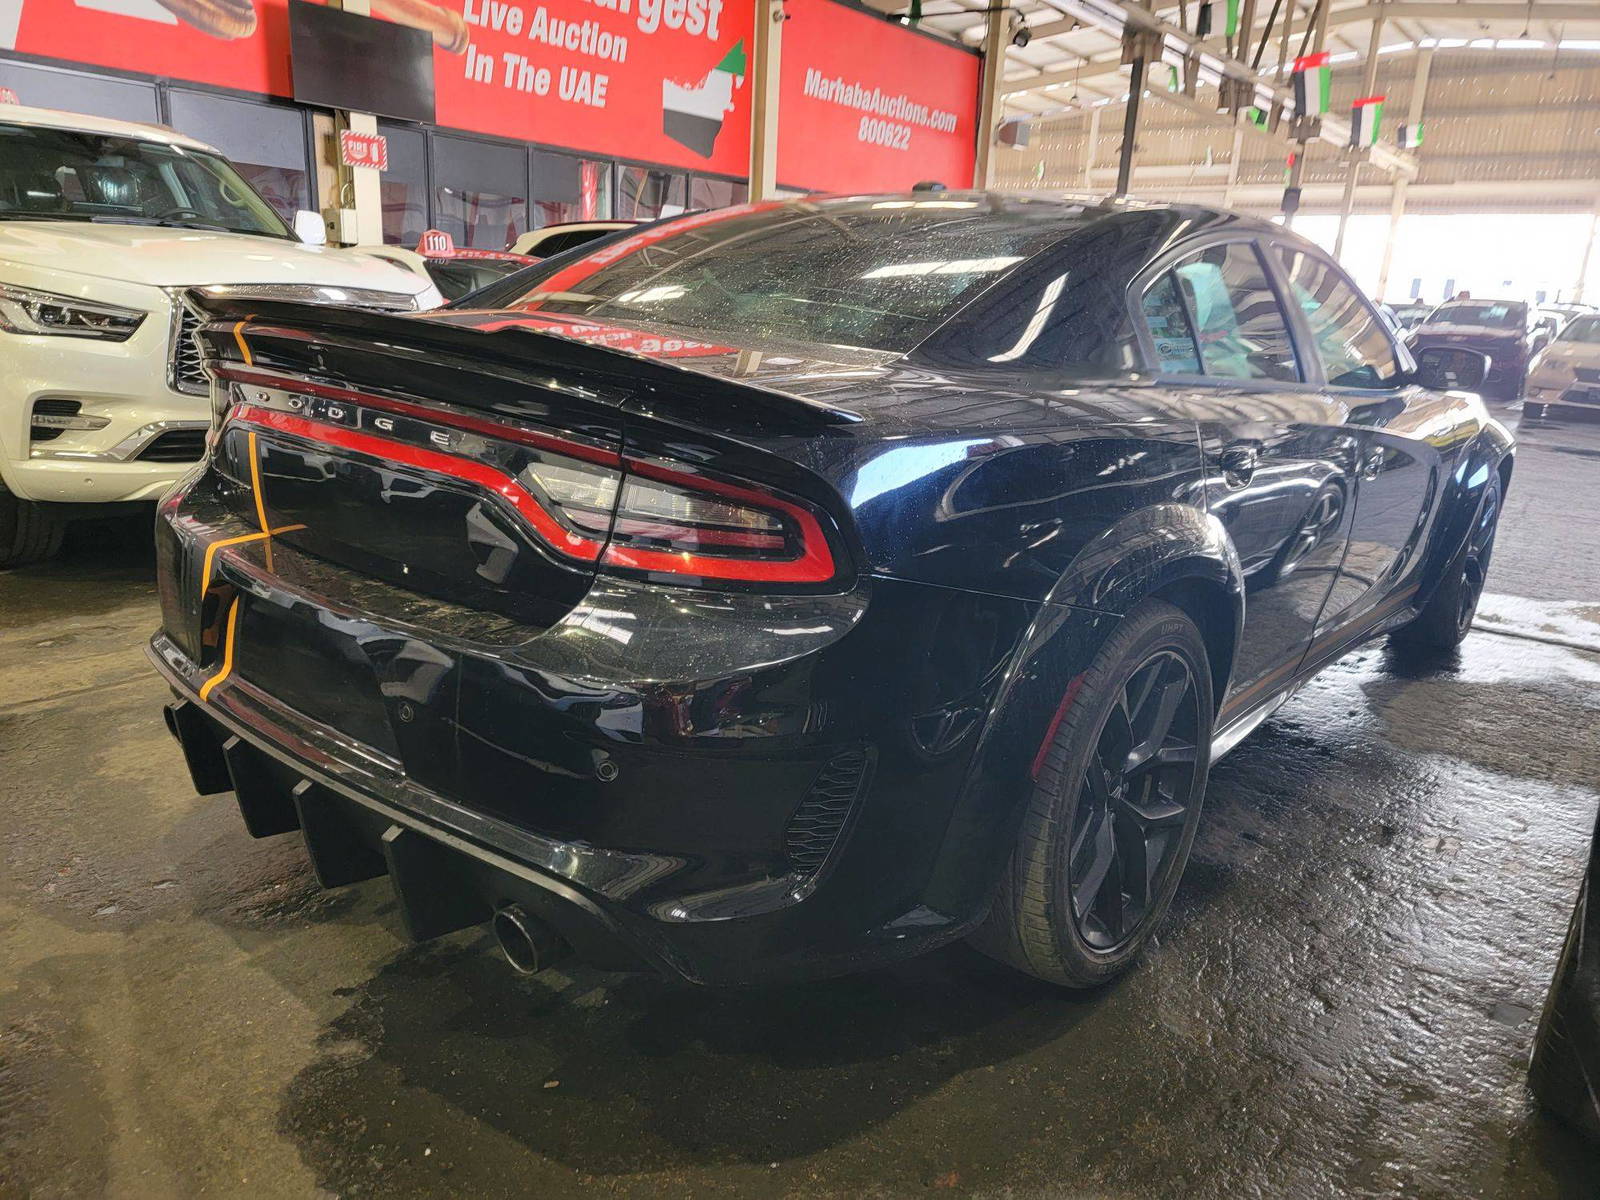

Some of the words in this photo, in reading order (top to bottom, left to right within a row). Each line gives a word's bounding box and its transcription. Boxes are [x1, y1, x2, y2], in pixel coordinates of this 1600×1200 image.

[463, 0, 524, 36] Live
[528, 6, 628, 63] Auction
[464, 44, 495, 84] In
[503, 52, 551, 97] The
[558, 66, 609, 108] UAE
[803, 67, 958, 133] MarhabaAuctions.com
[427, 235, 447, 251] 110
[256, 391, 450, 446] DODGE
